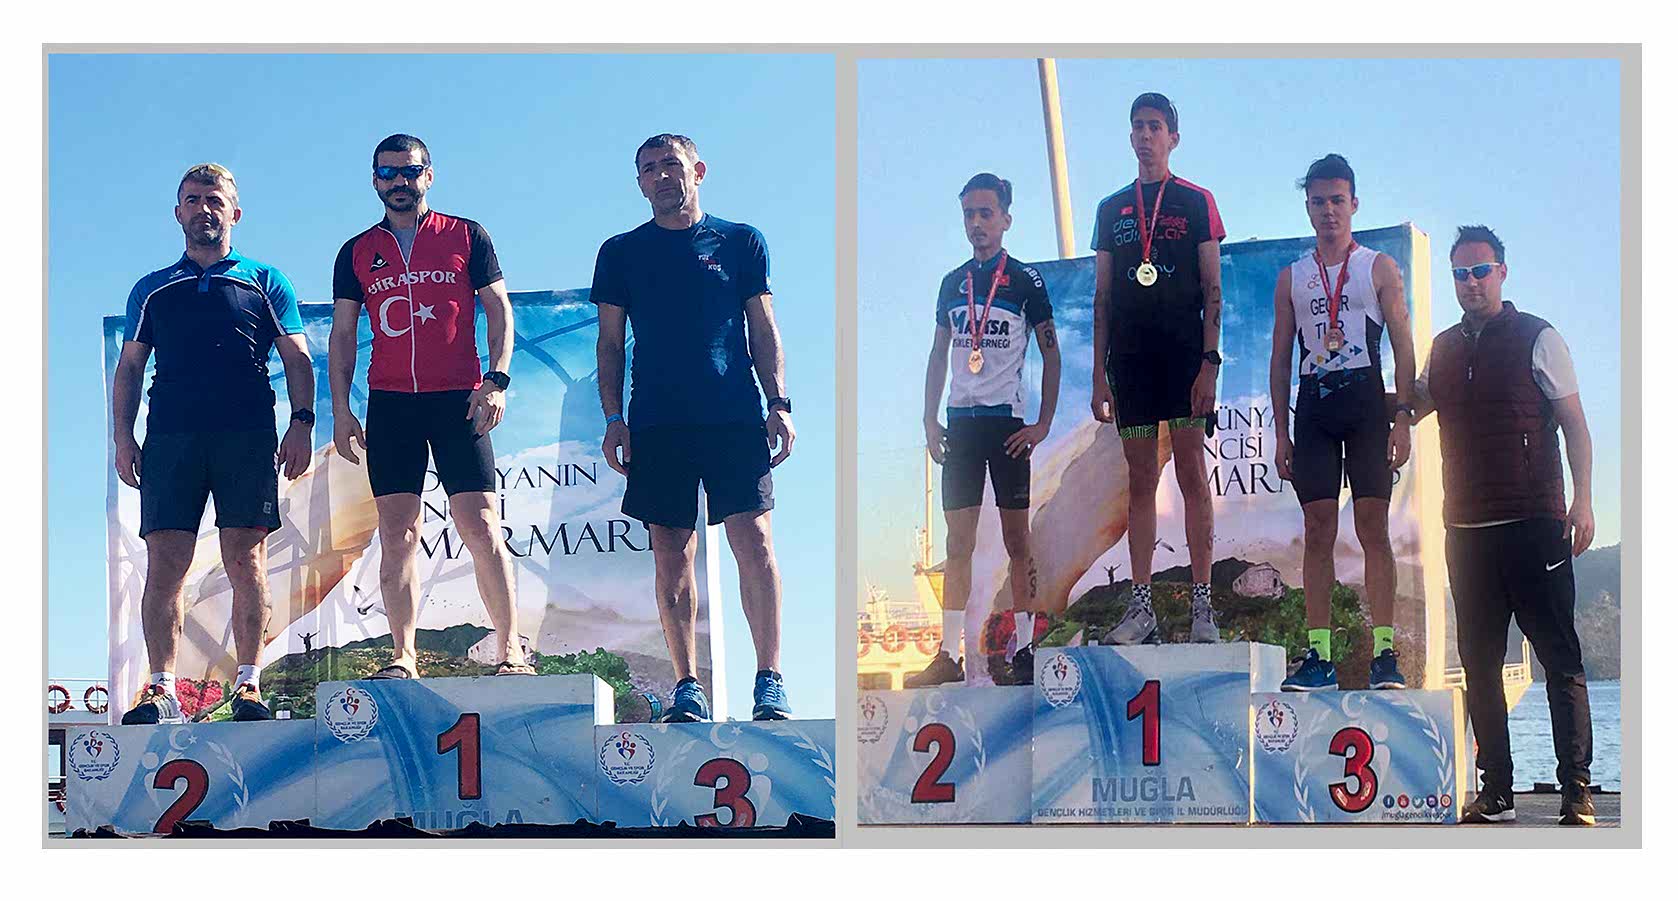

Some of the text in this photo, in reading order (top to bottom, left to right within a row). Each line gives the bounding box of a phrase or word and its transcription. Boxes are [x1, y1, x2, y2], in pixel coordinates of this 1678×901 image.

[1310, 295, 1349, 315] GER
[422, 462, 598, 493] DYANIN
[437, 712, 482, 801] 1
[1126, 679, 1161, 767] 1
[153, 758, 210, 834] 2
[693, 757, 757, 828] 3
[910, 722, 956, 804] 2
[1091, 770, 1196, 802] MUĞLA
[1328, 726, 1378, 813] 3
